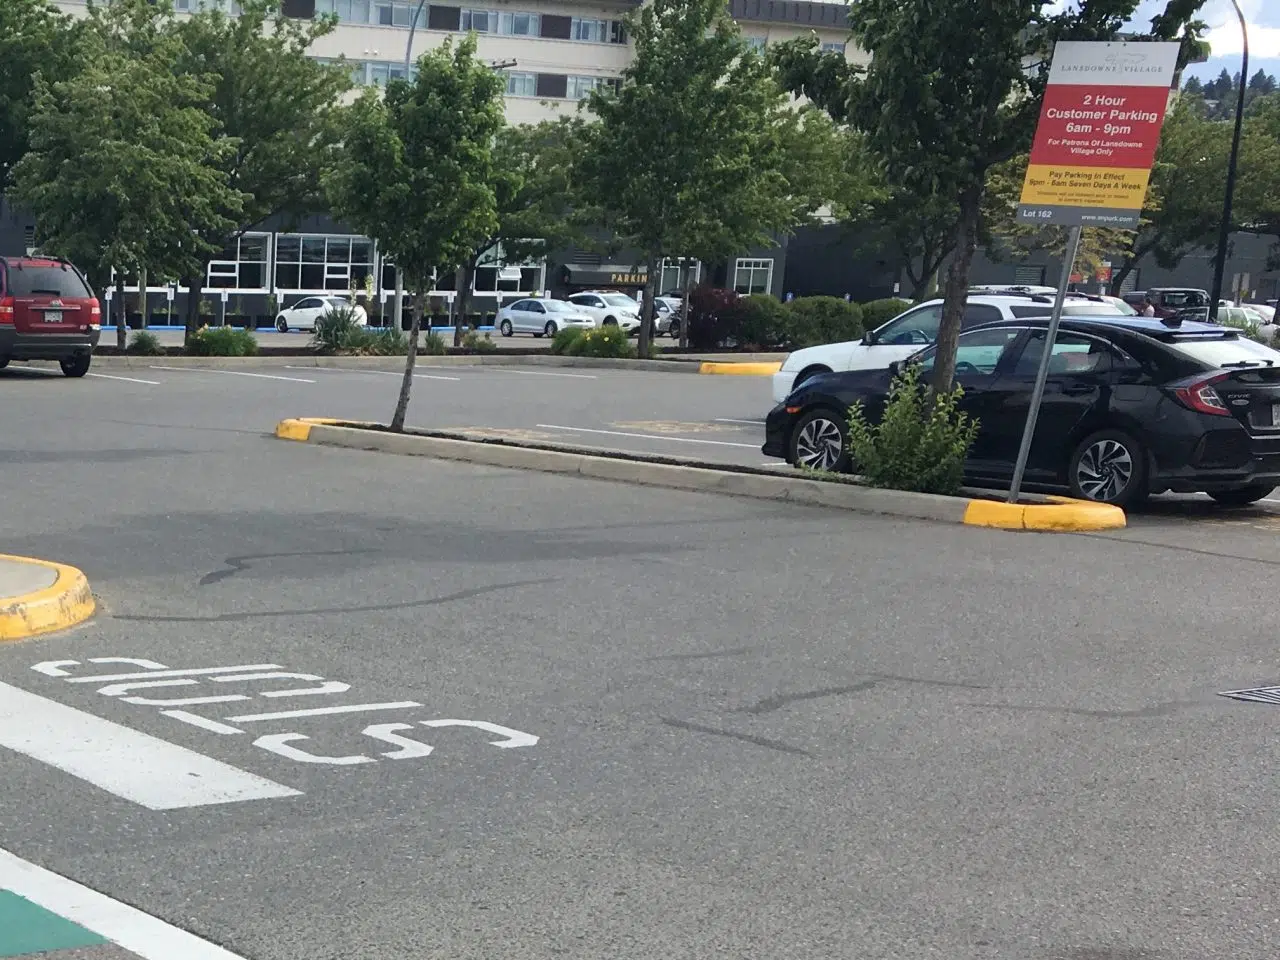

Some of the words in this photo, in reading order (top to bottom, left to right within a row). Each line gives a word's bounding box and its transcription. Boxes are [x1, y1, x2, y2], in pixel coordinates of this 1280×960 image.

[1061, 65, 1118, 73] LANSDOWNE
[1083, 95, 1092, 105] 2
[1095, 95, 1126, 106] Hour
[1046, 108, 1107, 119] Customer
[1110, 110, 1158, 123] Parking
[1066, 122, 1092, 133] 6am
[1104, 123, 1131, 135] 9pm
[1062, 139, 1089, 147] Patrons
[1070, 147, 1095, 155] Village
[1096, 148, 1113, 156] Only
[1049, 171, 1063, 181] Pay
[1064, 172, 1093, 181] Parking
[1068, 180, 1091, 188] Seven
[1093, 182, 1112, 190] Days
[1023, 210, 1036, 218] Lot
[611, 273, 648, 282] PARKIN
[31, 656, 540, 765] STOP
